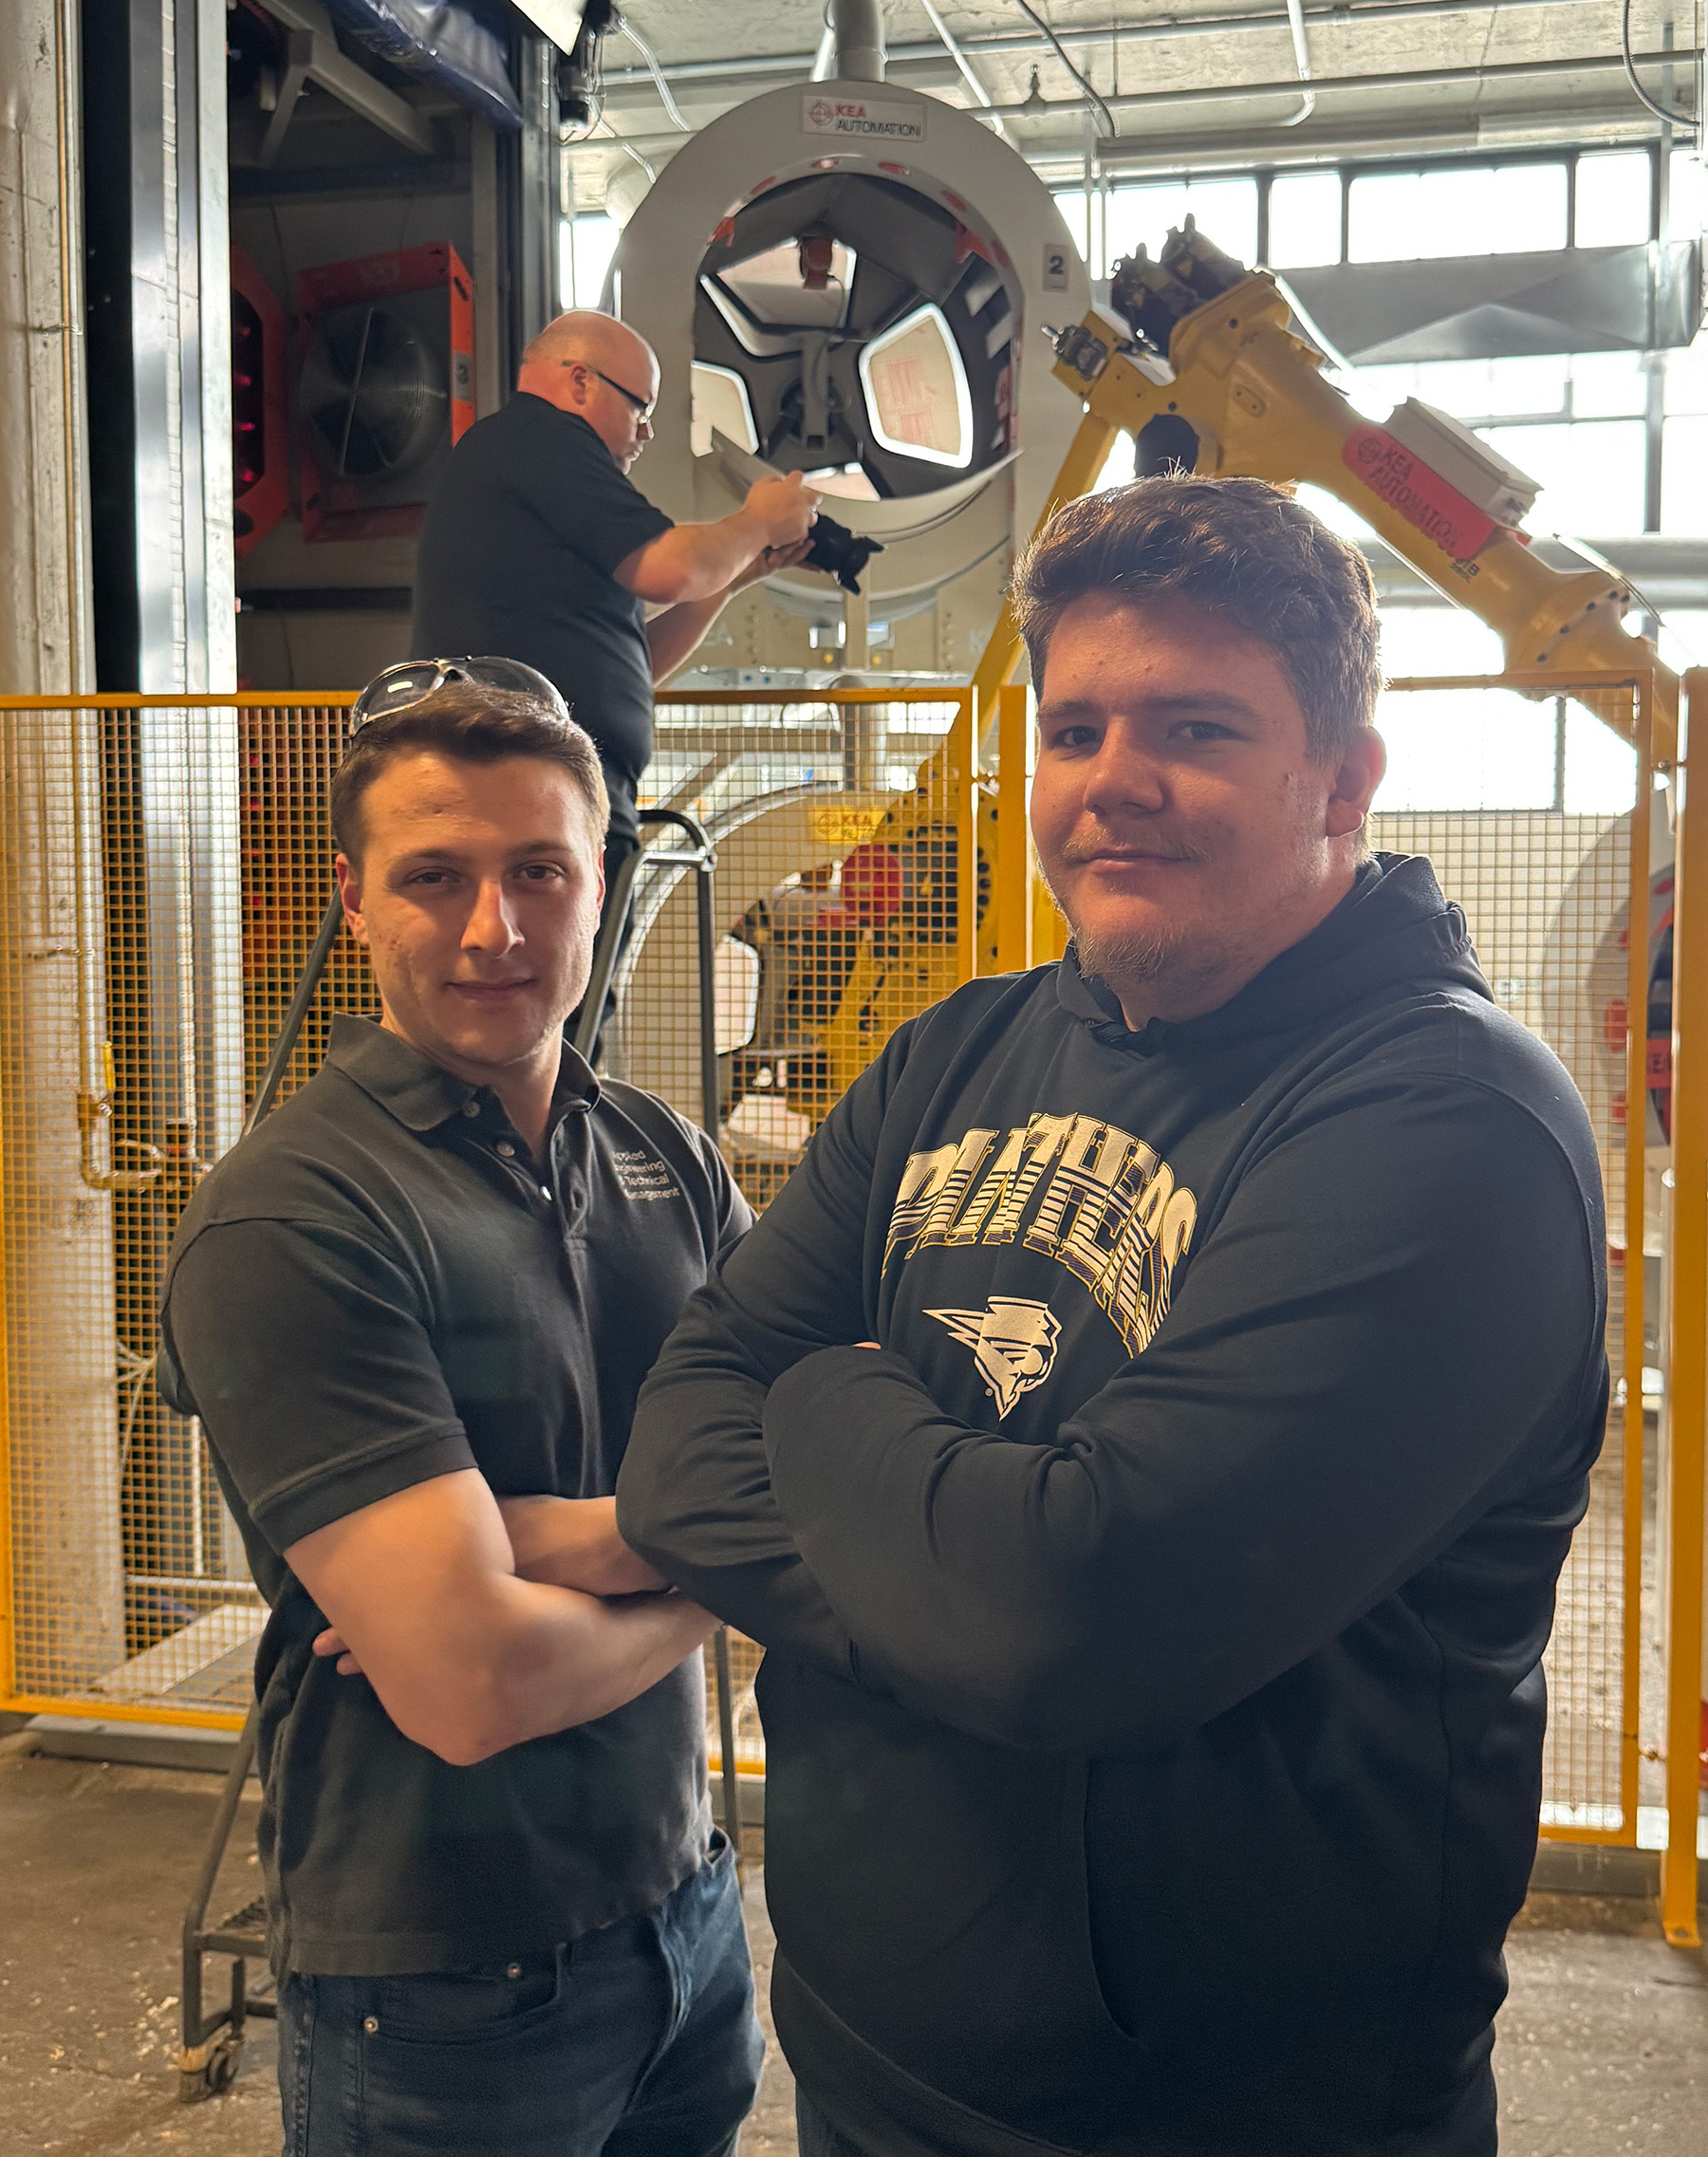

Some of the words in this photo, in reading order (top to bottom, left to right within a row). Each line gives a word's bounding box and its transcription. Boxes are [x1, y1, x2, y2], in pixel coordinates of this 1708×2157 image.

[835, 103, 866, 118] KEA
[836, 120, 921, 138] AUTOMATION
[1049, 255, 1064, 275] 2
[1380, 446, 1414, 480] KEA
[1368, 464, 1461, 550] AUTOMATION
